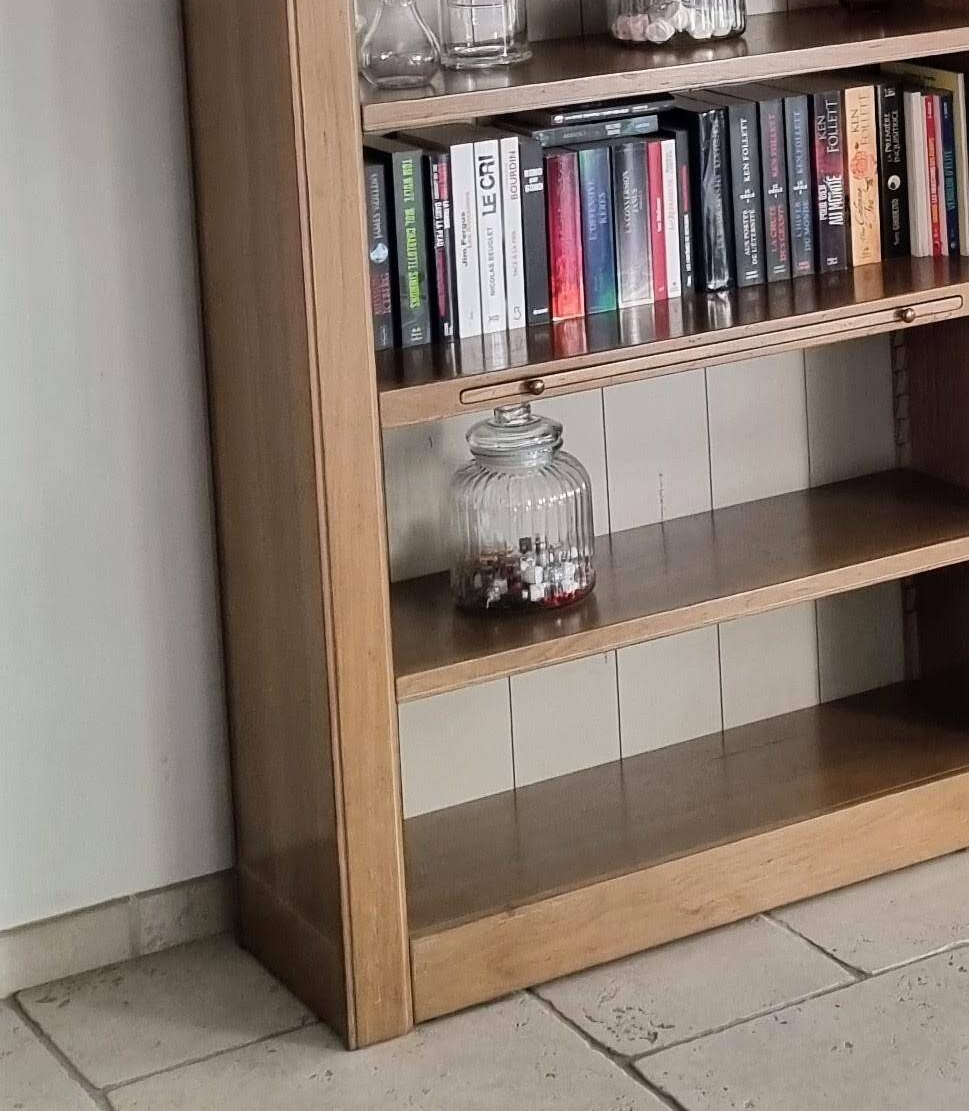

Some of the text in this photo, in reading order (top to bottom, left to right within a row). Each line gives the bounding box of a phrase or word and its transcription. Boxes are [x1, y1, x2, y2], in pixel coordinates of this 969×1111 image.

[768, 113, 779, 178] KEN FOLLETT
[793, 110, 803, 174] KEN FOLLETT
[817, 115, 827, 140] KEN
[825, 100, 840, 153] FOLLETT
[850, 108, 859, 133] KEN
[858, 94, 870, 146] FOLLETT
[402, 159, 413, 176] TOM
[509, 150, 519, 201] BOURDIN
[740, 118, 751, 182] KEN FOLLETT
[479, 155, 497, 216] LE CRI
[373, 214, 383, 239] JAMES
[828, 211, 844, 225] AU
